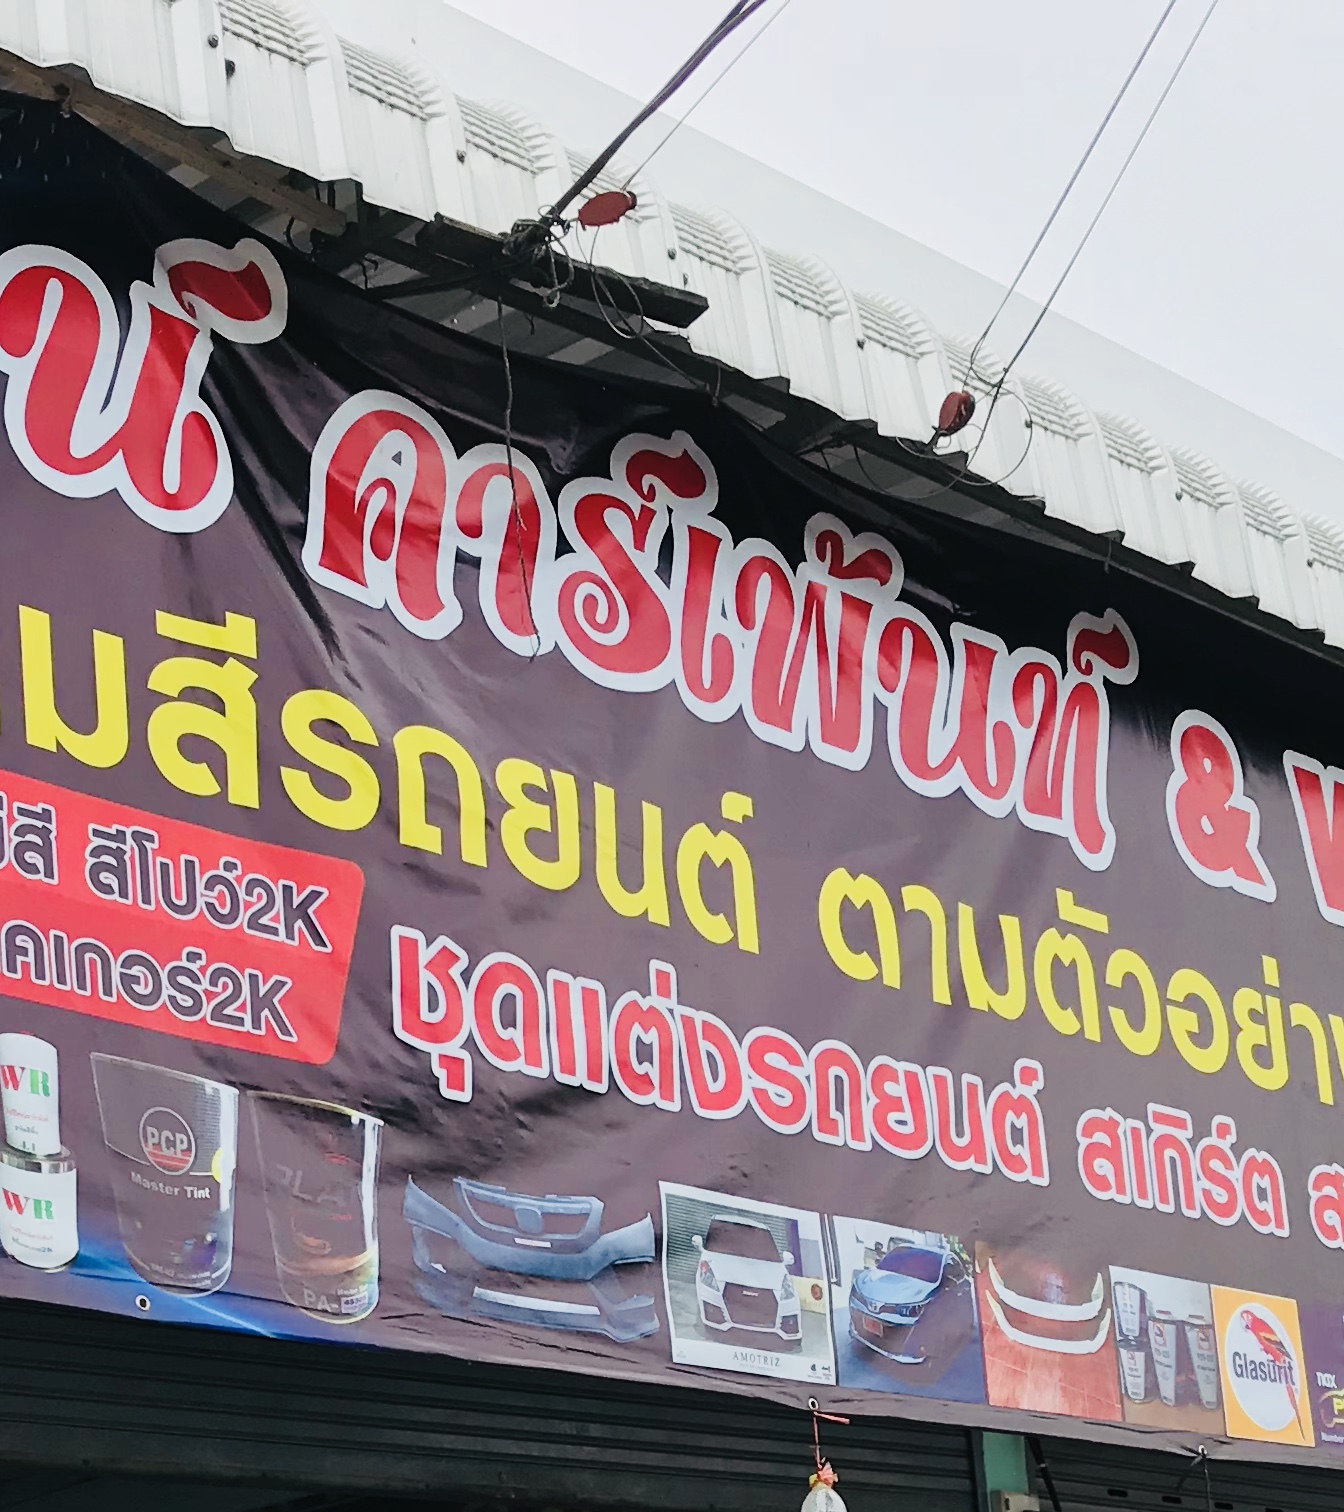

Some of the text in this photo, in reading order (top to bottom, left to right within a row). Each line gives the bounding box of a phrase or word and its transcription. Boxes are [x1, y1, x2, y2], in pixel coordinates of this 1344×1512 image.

[1167, 710, 1276, 901] &
[390, 924, 1049, 1187] ชุดแต่งรถยนต์
[1076, 1102, 1290, 1238] สเกิร์ต
[145, 1126, 189, 1156] PCP
[130, 1170, 211, 1199] Master Tint
[2, 1187, 54, 1220] WR
[1232, 1351, 1297, 1389] Glasurit
